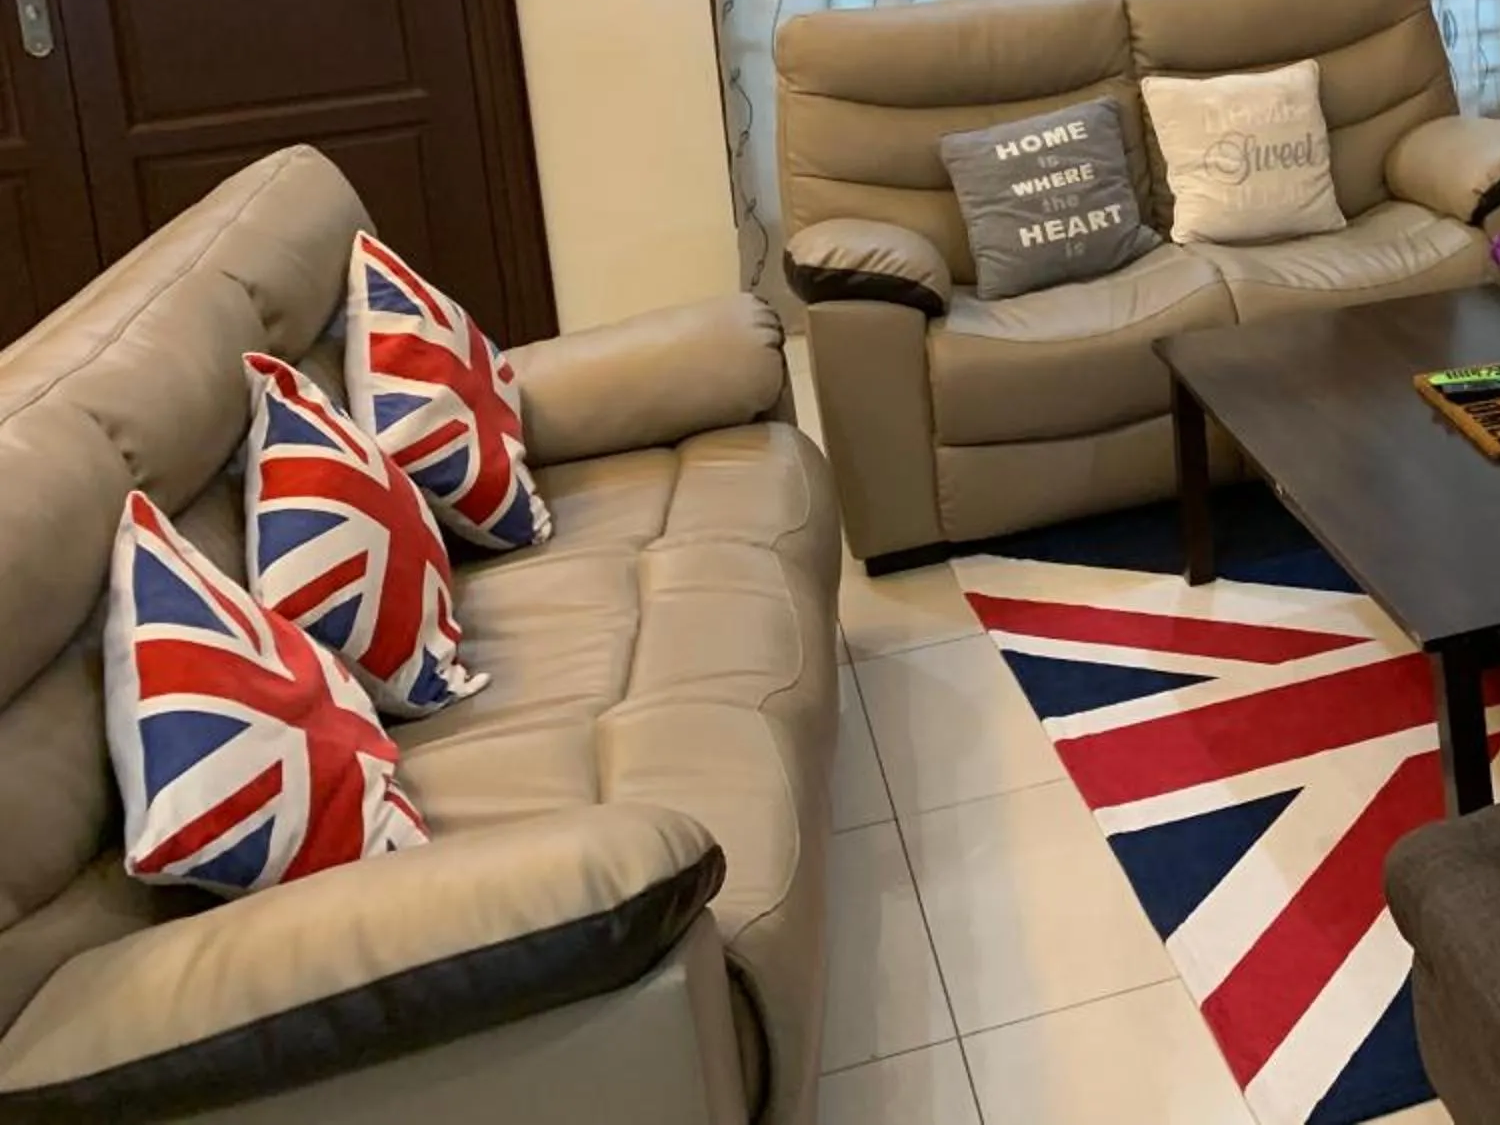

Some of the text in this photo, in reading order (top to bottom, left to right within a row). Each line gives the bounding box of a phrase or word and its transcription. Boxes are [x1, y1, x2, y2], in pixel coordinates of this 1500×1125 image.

[995, 121, 1089, 161] HOME
[1203, 131, 1317, 186] Sweet
[1011, 163, 1095, 197] WHERE
[1041, 193, 1080, 213] the
[1018, 204, 1123, 248] HEART
